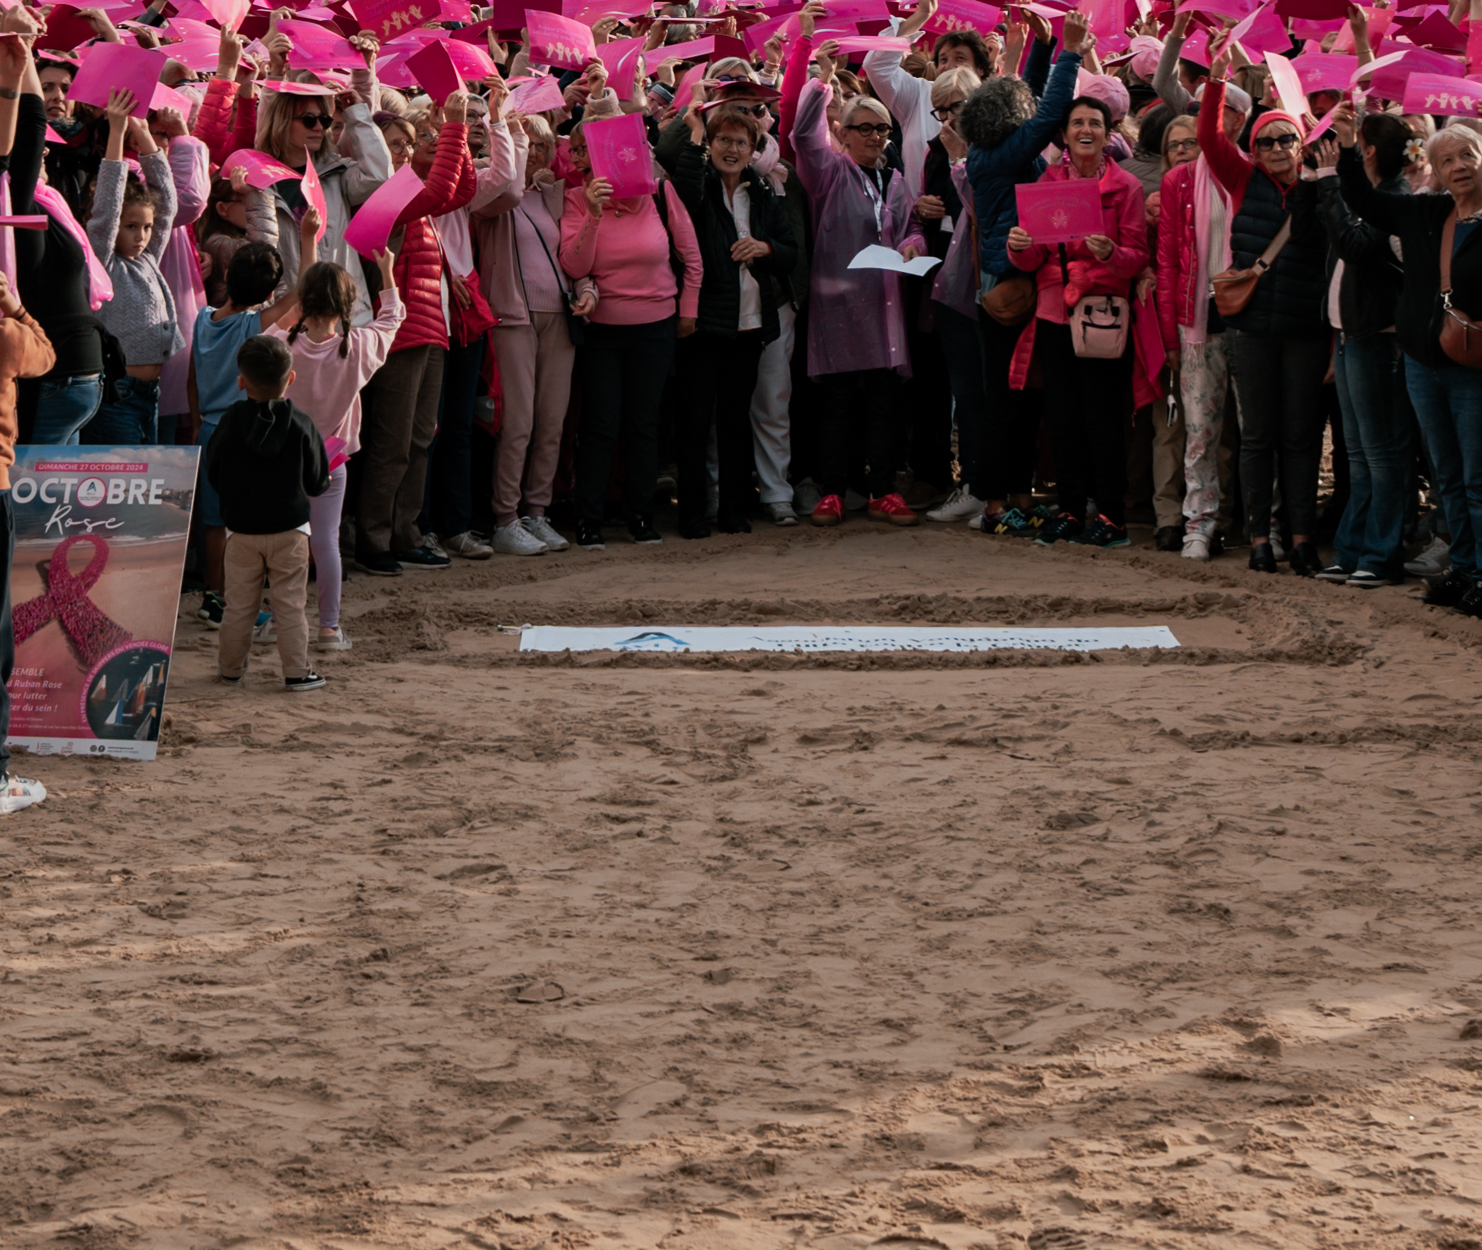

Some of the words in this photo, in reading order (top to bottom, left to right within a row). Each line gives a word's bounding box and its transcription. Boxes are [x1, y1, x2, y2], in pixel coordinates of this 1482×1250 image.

[38, 463, 78, 471] DIMANCHE
[79, 463, 89, 471] 27
[89, 463, 124, 471] OCTOBRE
[44, 504, 126, 536] Rose
[10, 668, 45, 676] SEMBLE
[14, 679, 40, 687] Ruban
[42, 680, 63, 689] Rose
[22, 691, 48, 700] lutter
[22, 703, 33, 712] du
[35, 703, 52, 712] sein
